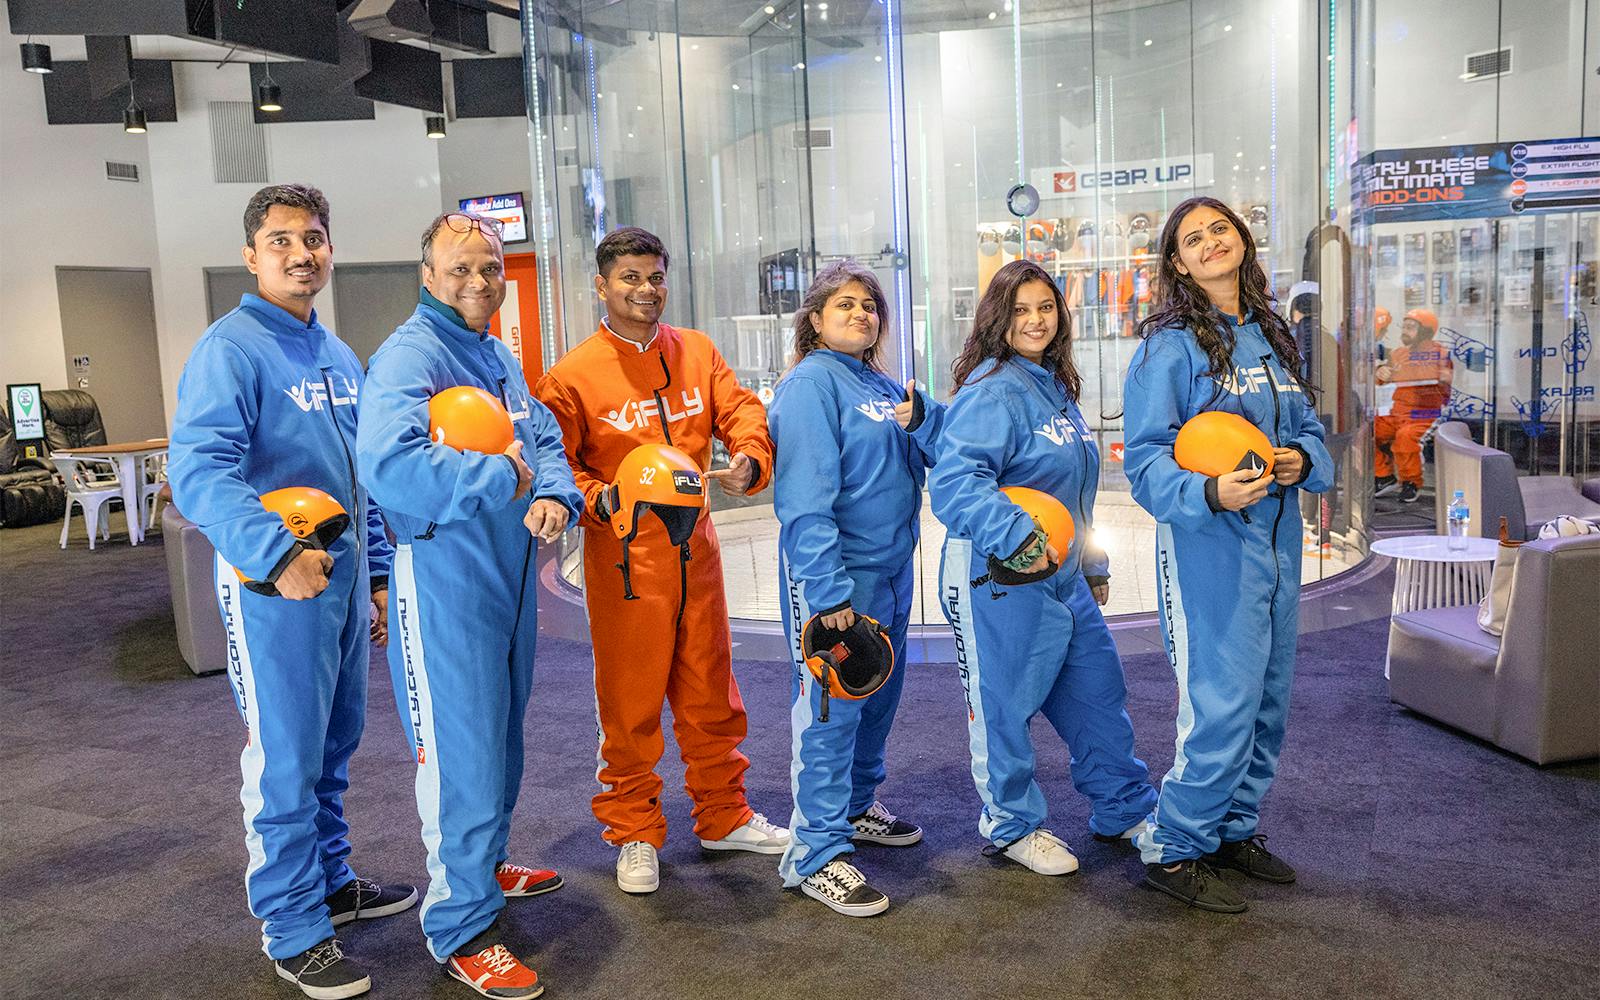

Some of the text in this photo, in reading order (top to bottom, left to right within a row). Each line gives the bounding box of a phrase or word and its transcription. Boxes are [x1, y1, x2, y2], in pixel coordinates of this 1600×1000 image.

[1155, 164, 1191, 182] UP
[1415, 156, 1490, 174] THESE
[492, 199, 504, 209] Add
[505, 198, 517, 208] Ons
[511, 326, 521, 360] GAT
[305, 376, 358, 411] iFLY
[504, 389, 531, 421] LY
[631, 386, 704, 428] iFLY
[639, 466, 657, 485] 32
[673, 475, 702, 488] iFLY
